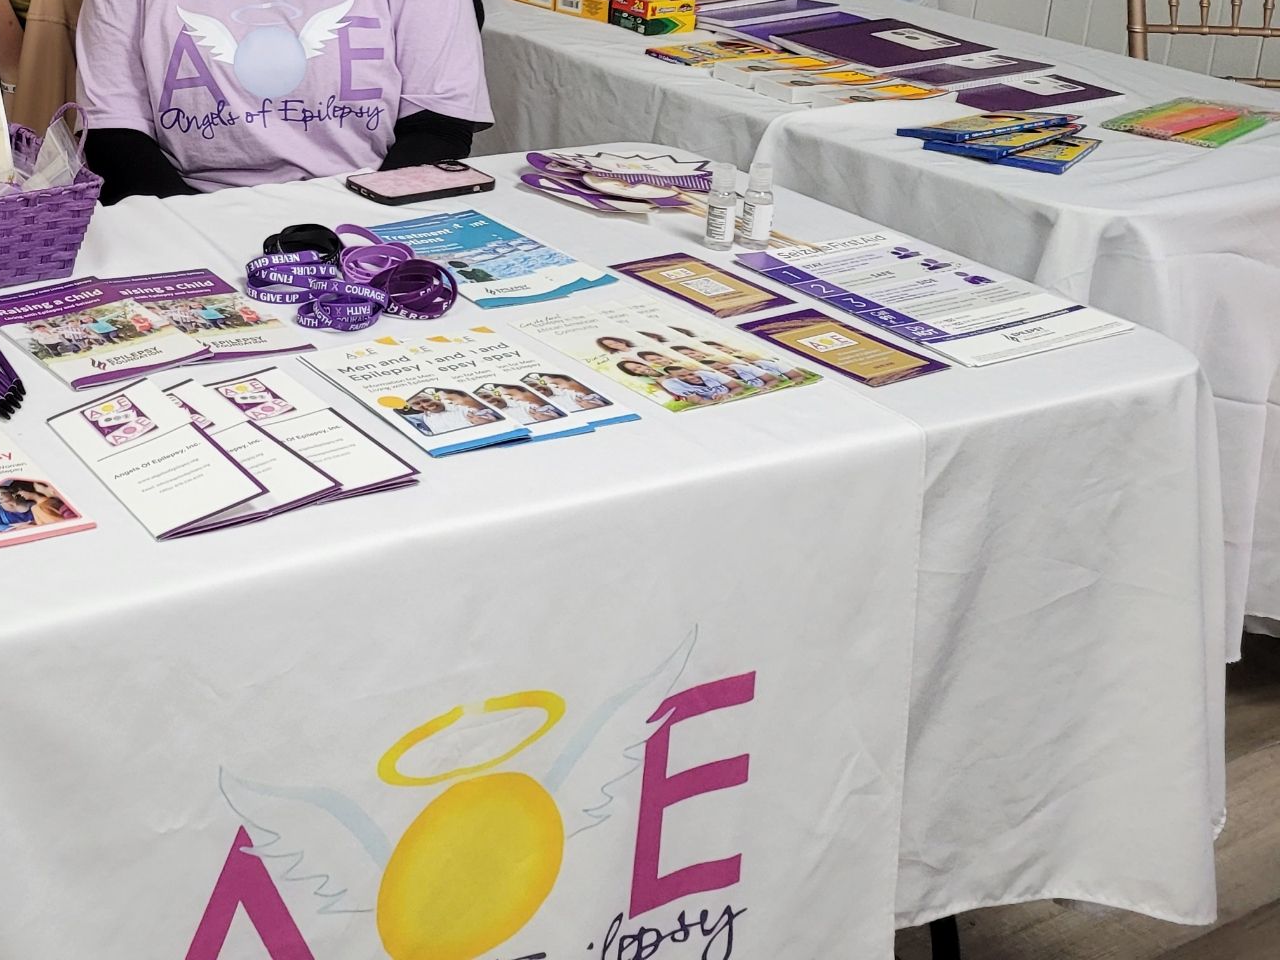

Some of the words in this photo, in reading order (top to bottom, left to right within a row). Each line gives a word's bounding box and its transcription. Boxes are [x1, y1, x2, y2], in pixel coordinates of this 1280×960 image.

[160, 99, 240, 140] Angels
[246, 98, 272, 129] of
[278, 95, 385, 132] Epilepsy
[383, 227, 451, 242] Treatment
[272, 253, 300, 265] NEVER
[782, 271, 802, 280] 1
[180, 279, 215, 290] Child
[810, 283, 834, 294] 2
[54, 297, 64, 305] a
[64, 289, 104, 304] Child
[260, 292, 284, 303] GIVE
[286, 293, 300, 303] UP
[344, 283, 386, 303] COURAGE
[842, 296, 866, 308] 3
[210, 335, 262, 347] EPILEPSY
[107, 346, 159, 363] EPILEPSY
[110, 350, 163, 366] FOUNDATION
[338, 362, 376, 375] Men
[375, 354, 411, 367] and
[349, 363, 421, 382] Epilepsy
[152, 448, 187, 465] Epilepsy,
[186, 441, 201, 453] Inc.
